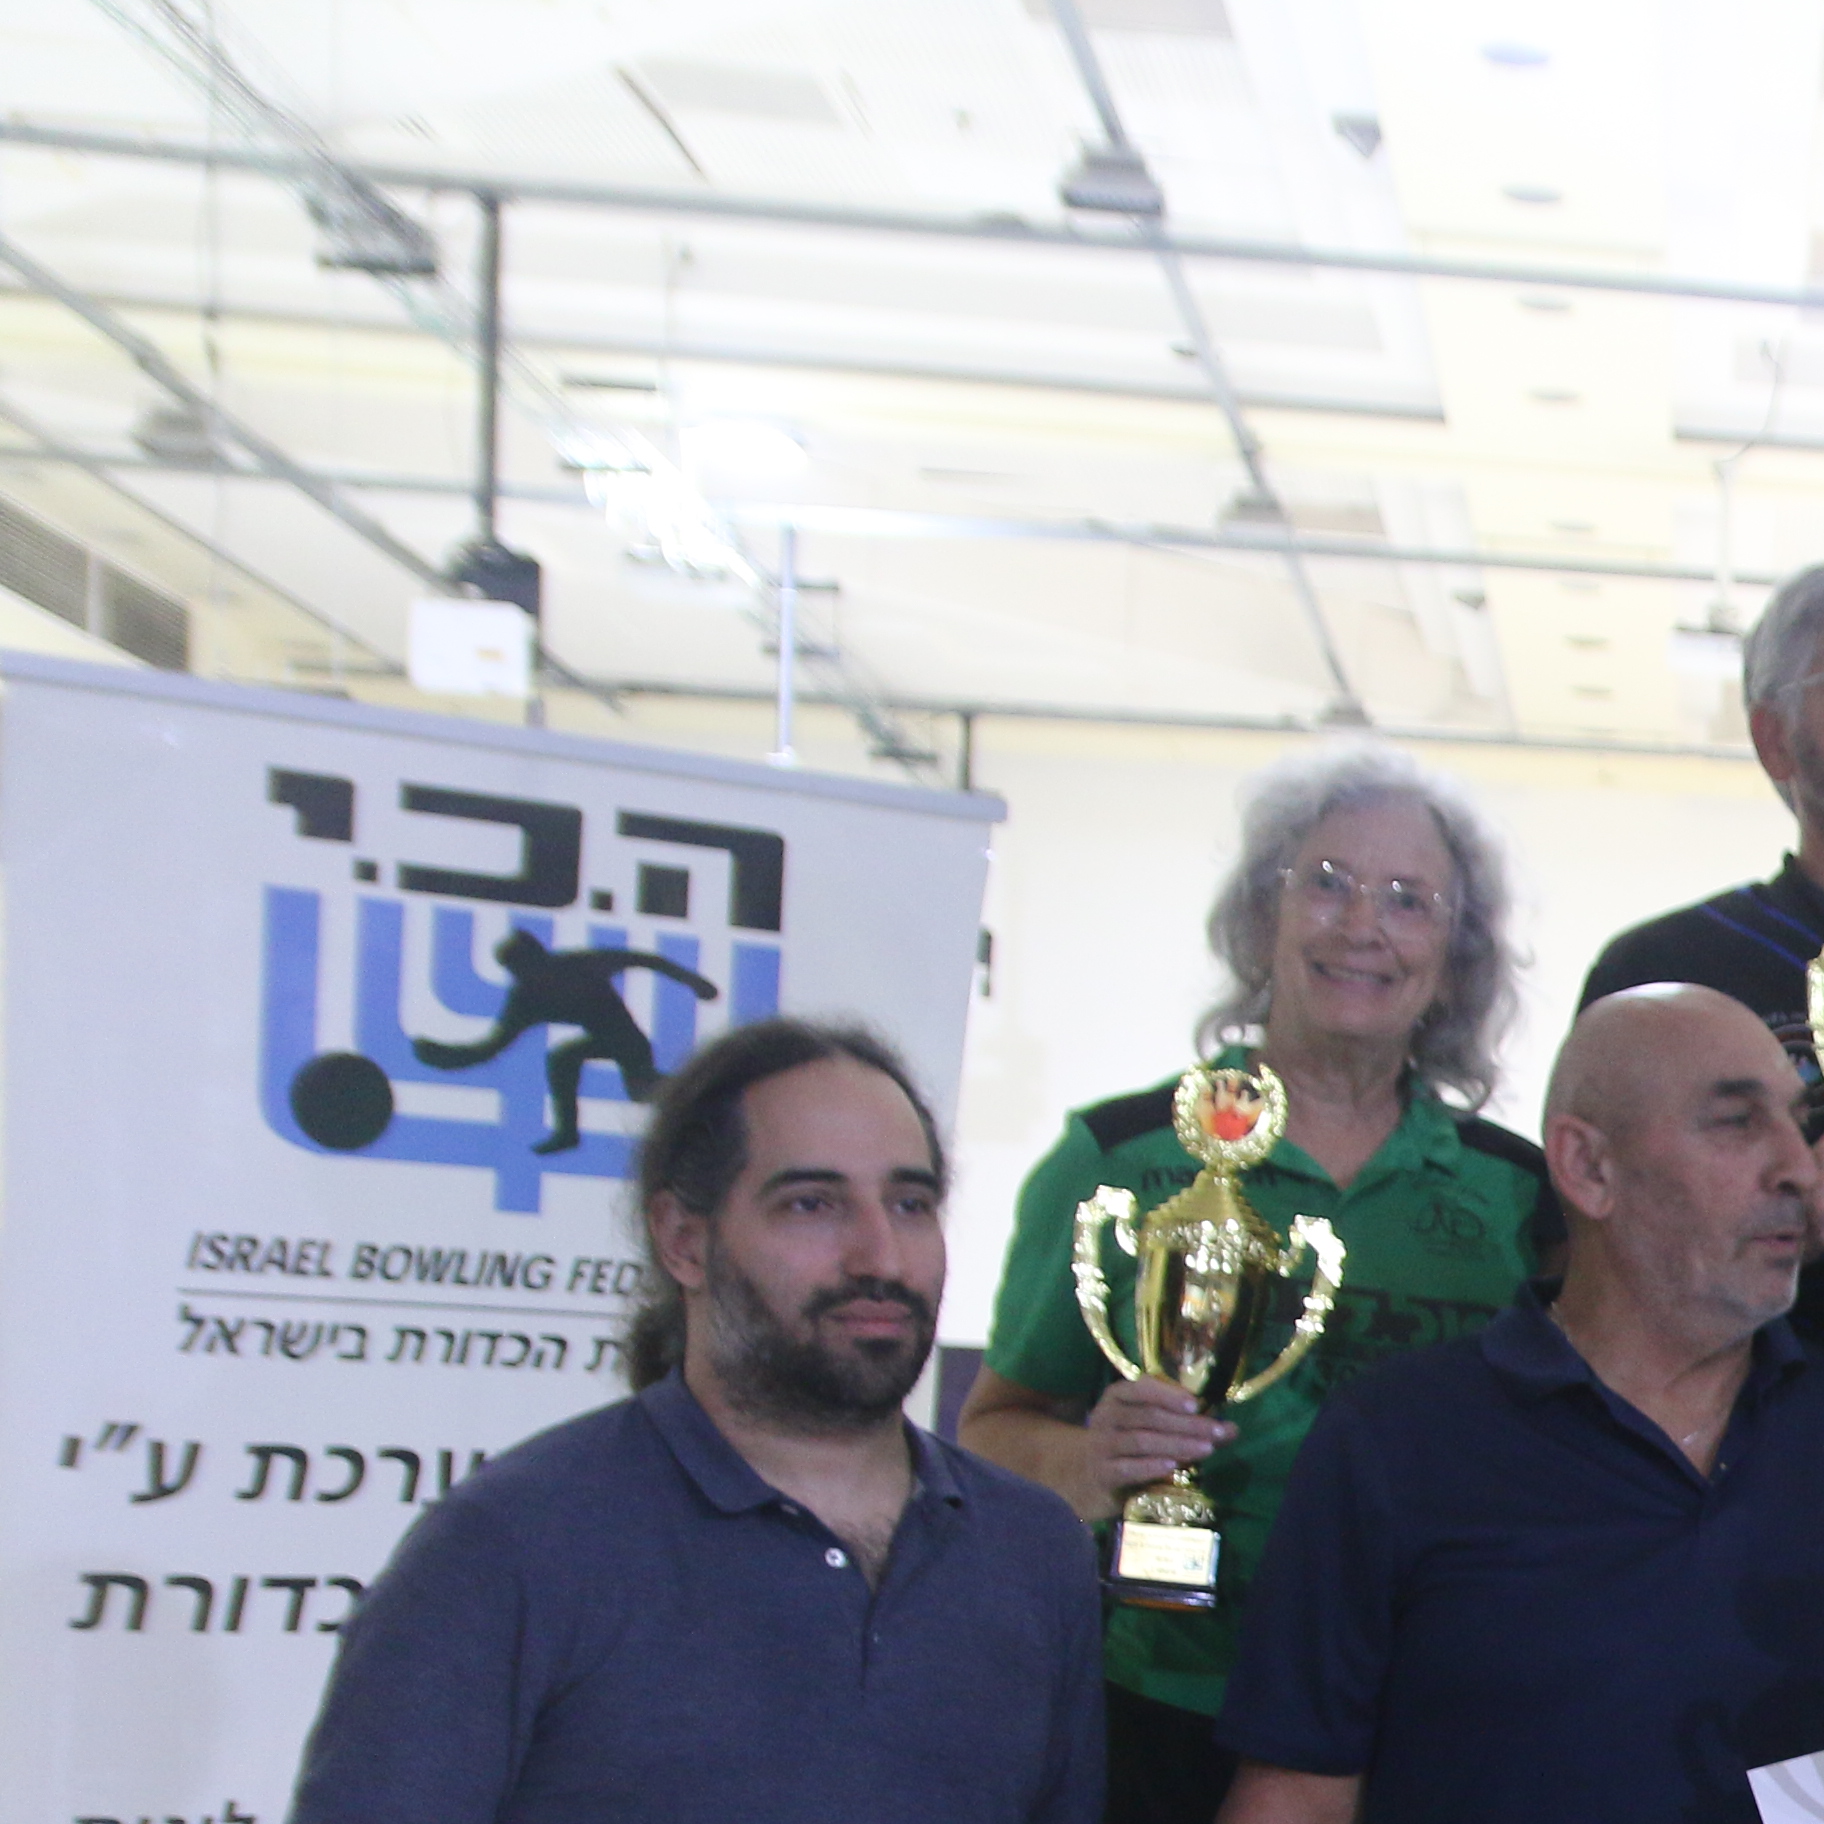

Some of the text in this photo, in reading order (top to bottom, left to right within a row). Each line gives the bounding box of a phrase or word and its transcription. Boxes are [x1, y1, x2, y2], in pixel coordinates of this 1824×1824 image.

[186, 1231, 334, 1278] ISRAEL
[349, 1242, 556, 1292] BOWLING
[177, 1304, 368, 1362] בישראל
[387, 1326, 567, 1370] הכדורת
